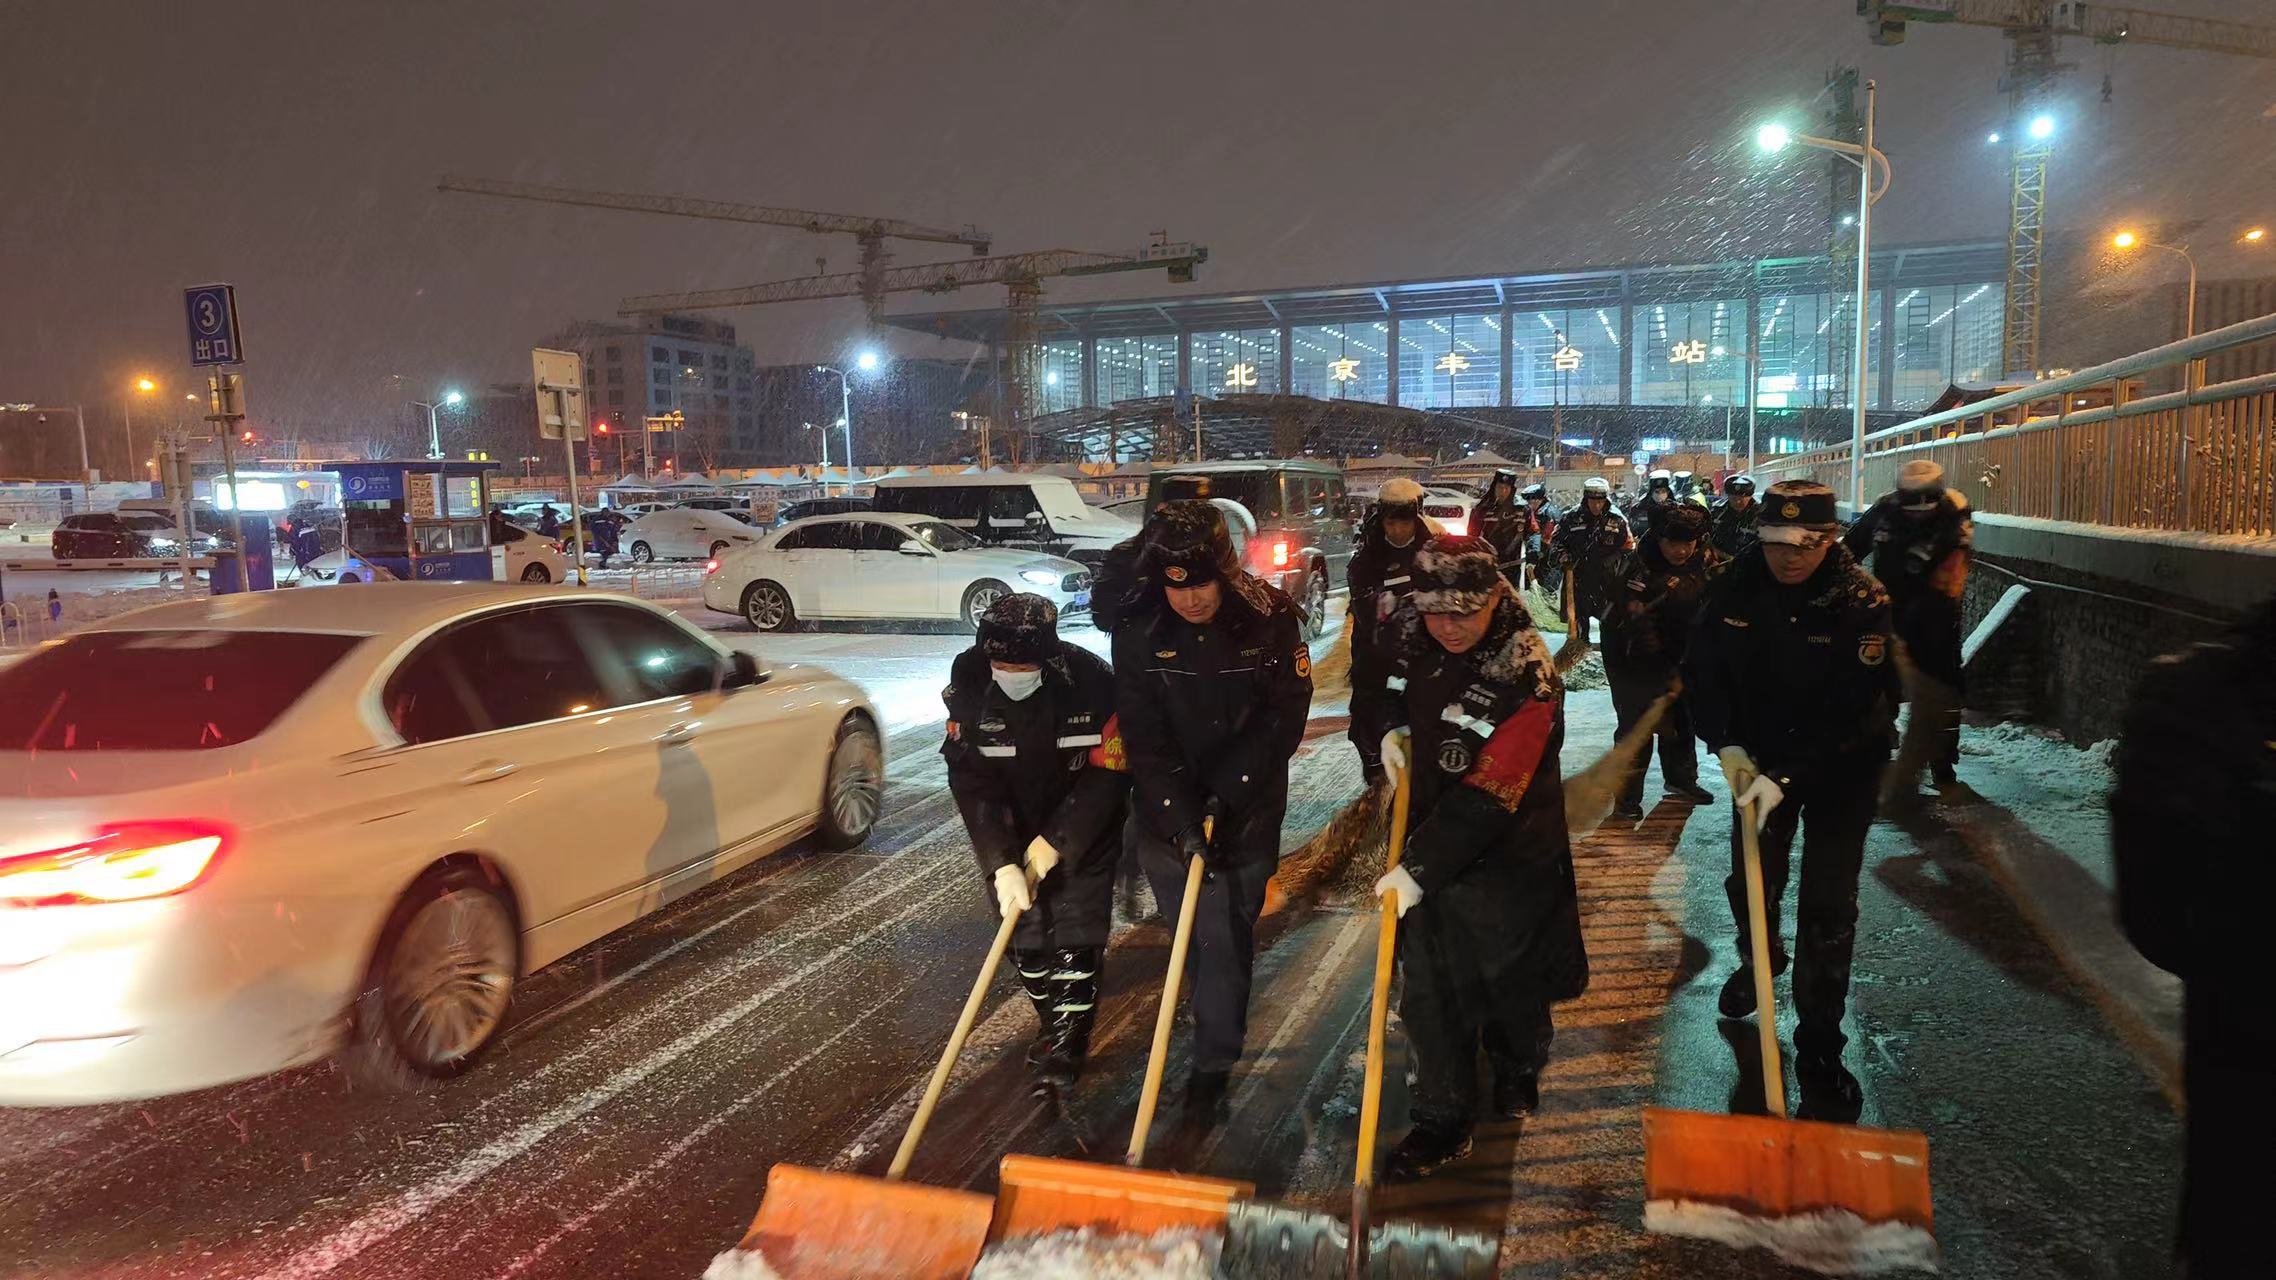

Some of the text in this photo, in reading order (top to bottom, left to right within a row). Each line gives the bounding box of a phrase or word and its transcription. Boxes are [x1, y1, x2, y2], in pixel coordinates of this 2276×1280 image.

[200, 300, 215, 327] 3
[195, 338, 229, 360] 出口
[1225, 339, 1706, 387] 北京丰台站
